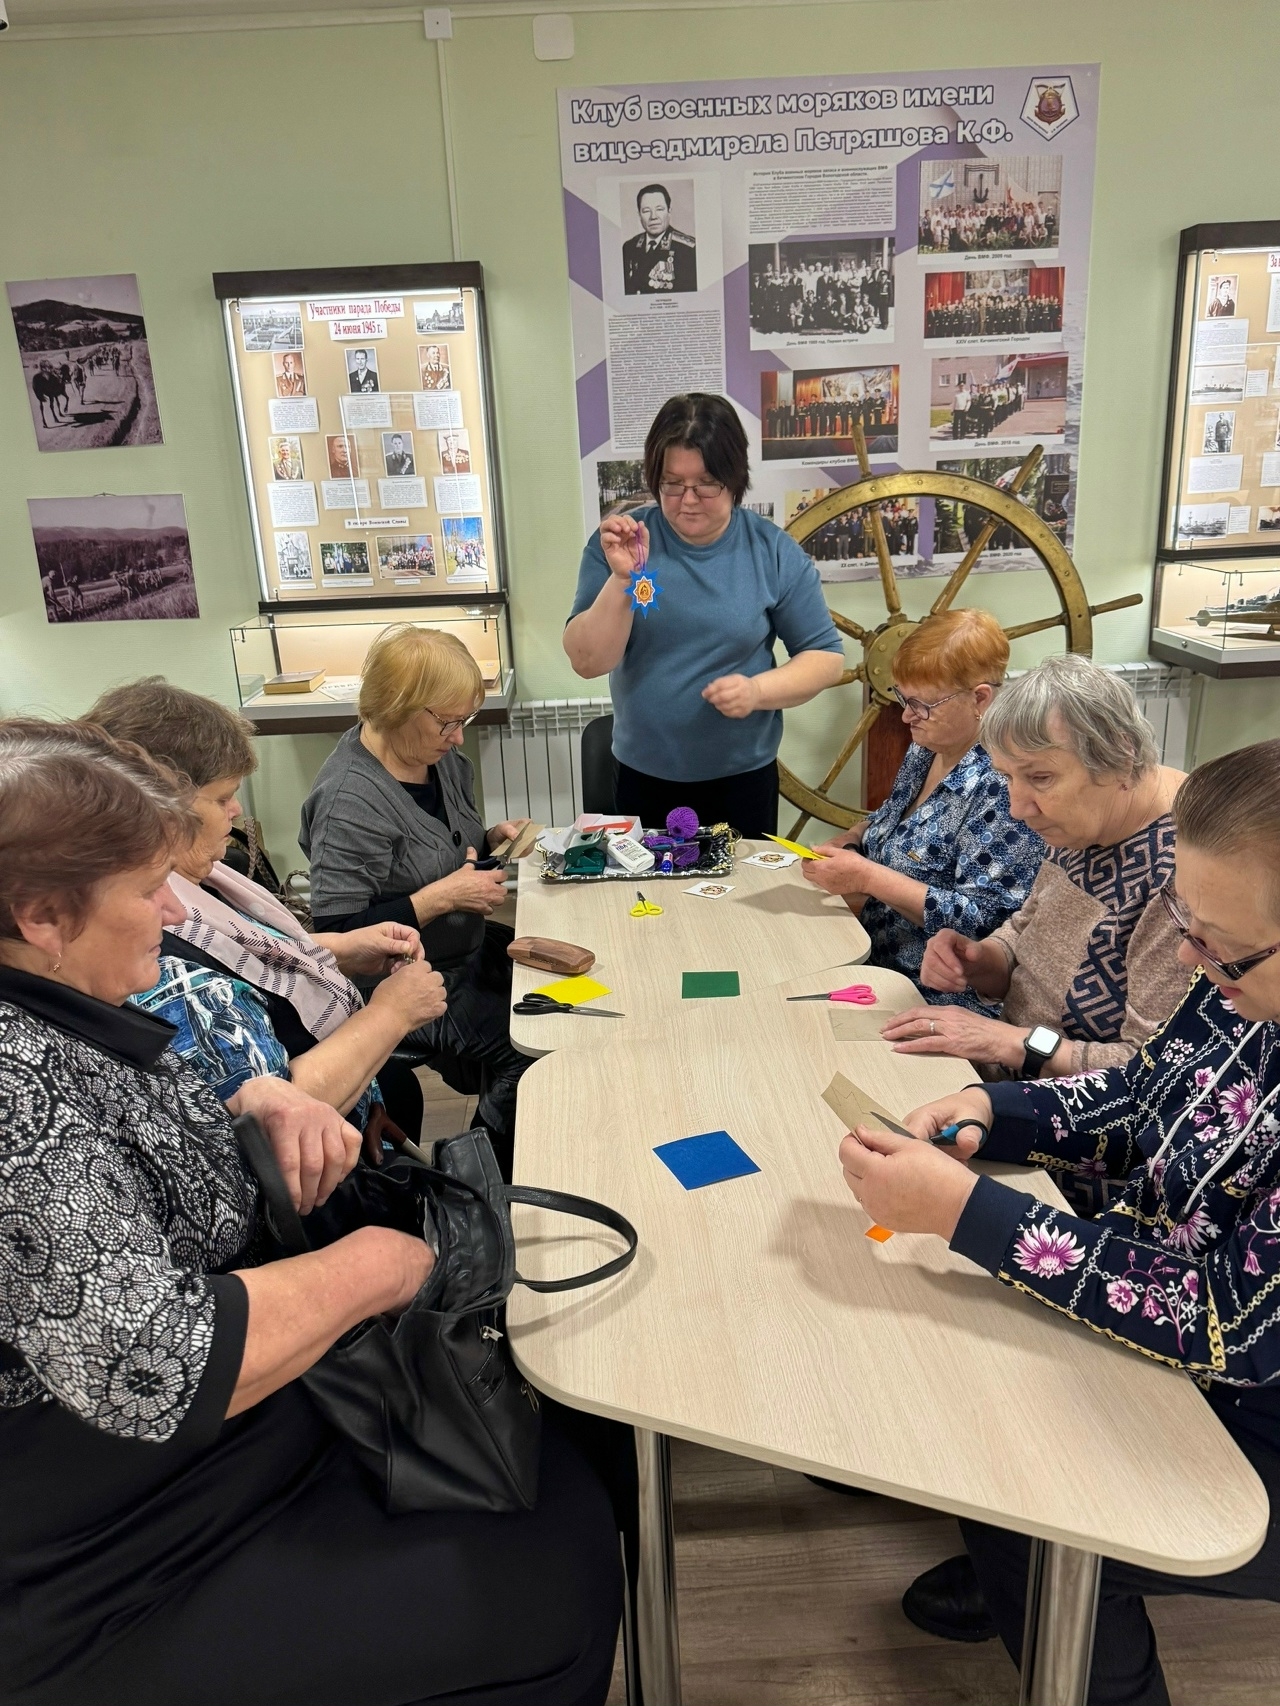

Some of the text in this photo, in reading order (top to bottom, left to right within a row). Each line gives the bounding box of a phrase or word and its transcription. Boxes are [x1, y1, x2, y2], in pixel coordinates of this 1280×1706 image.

[571, 85, 994, 128] Клуб военных моряков имени
[573, 133, 789, 164] вице-адмирала
[794, 125, 950, 155] Петряшова
[956, 118, 1014, 144] К.Ф.
[309, 300, 401, 319] Участники парада Победы
[333, 320, 383, 335] 24 июня 1945 г.
